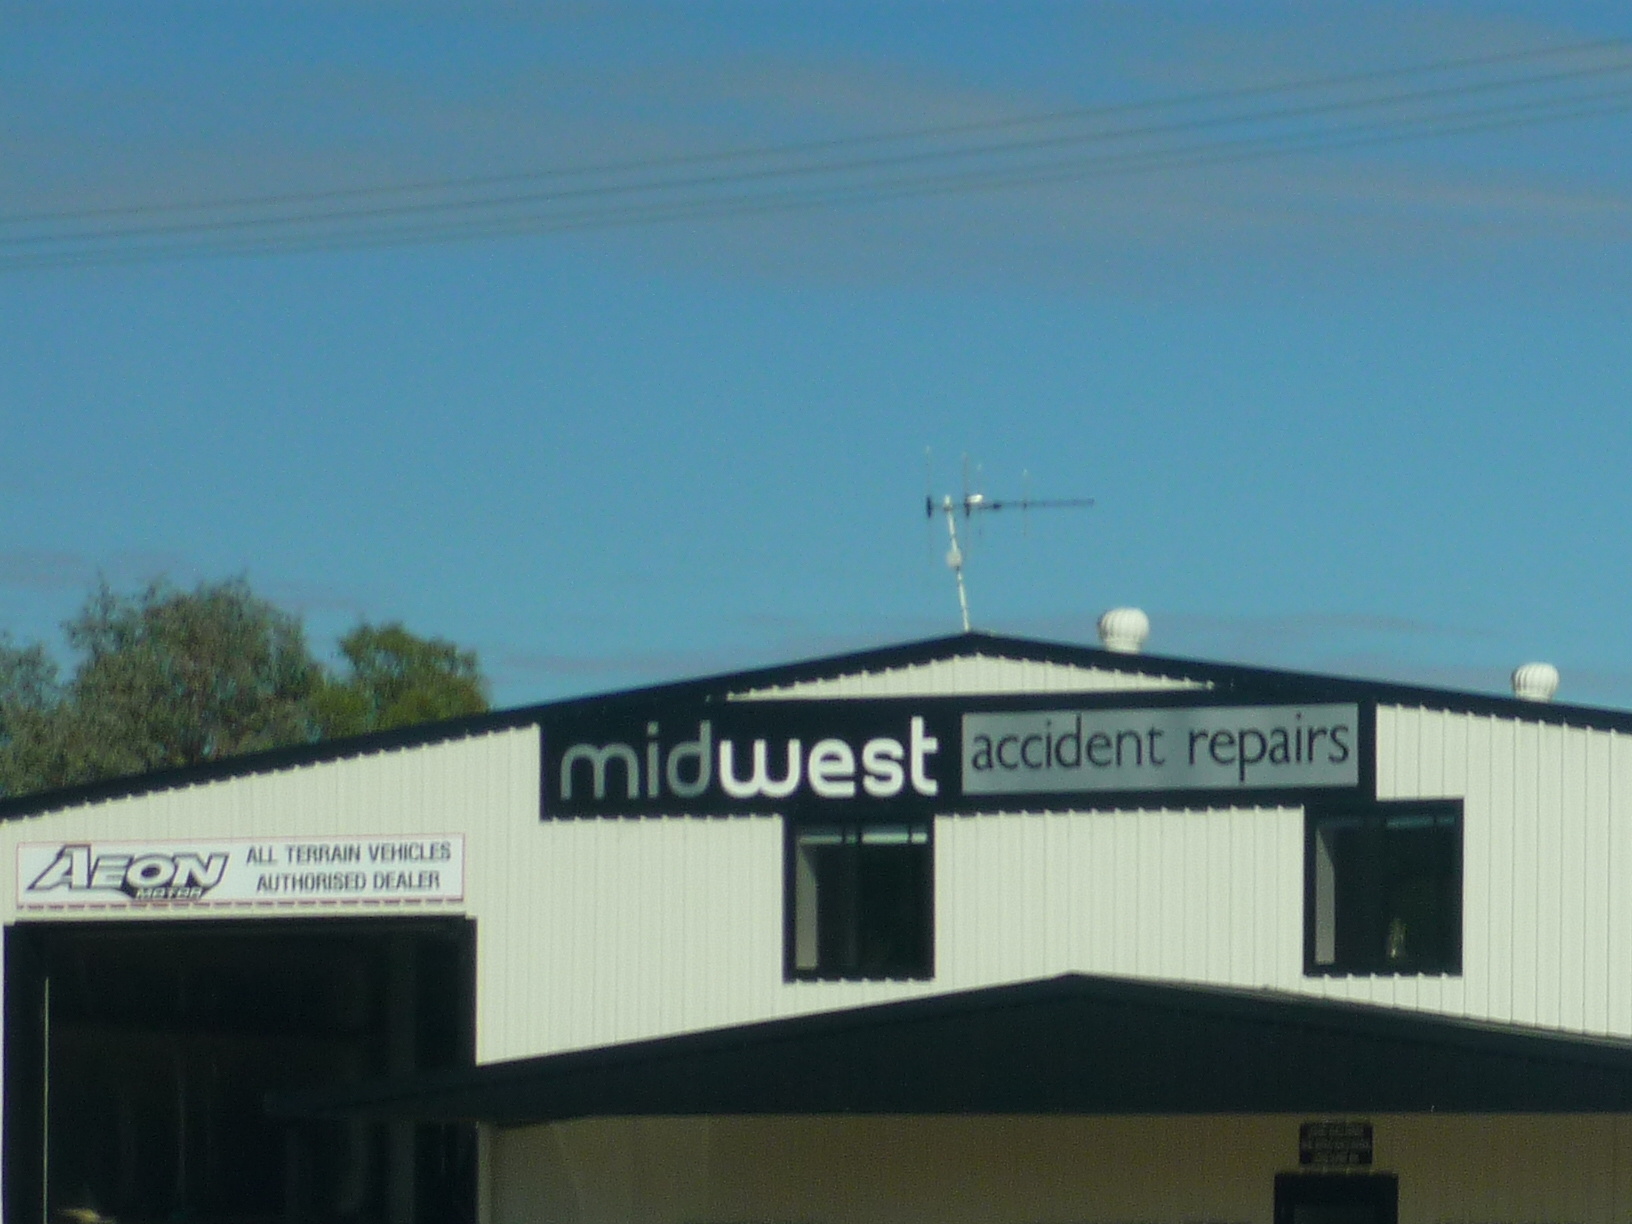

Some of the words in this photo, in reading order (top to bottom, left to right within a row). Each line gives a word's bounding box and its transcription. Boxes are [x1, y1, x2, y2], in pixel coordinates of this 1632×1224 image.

[560, 716, 938, 799] midwest
[970, 714, 1165, 770] accident
[1189, 714, 1350, 781] repairs
[26, 844, 229, 891] AEON
[246, 845, 278, 864] ALL
[287, 843, 361, 864] TERRAIN
[369, 842, 452, 862] VEHICLES
[256, 873, 366, 893] AUTHORISED
[374, 871, 440, 891] DEALER
